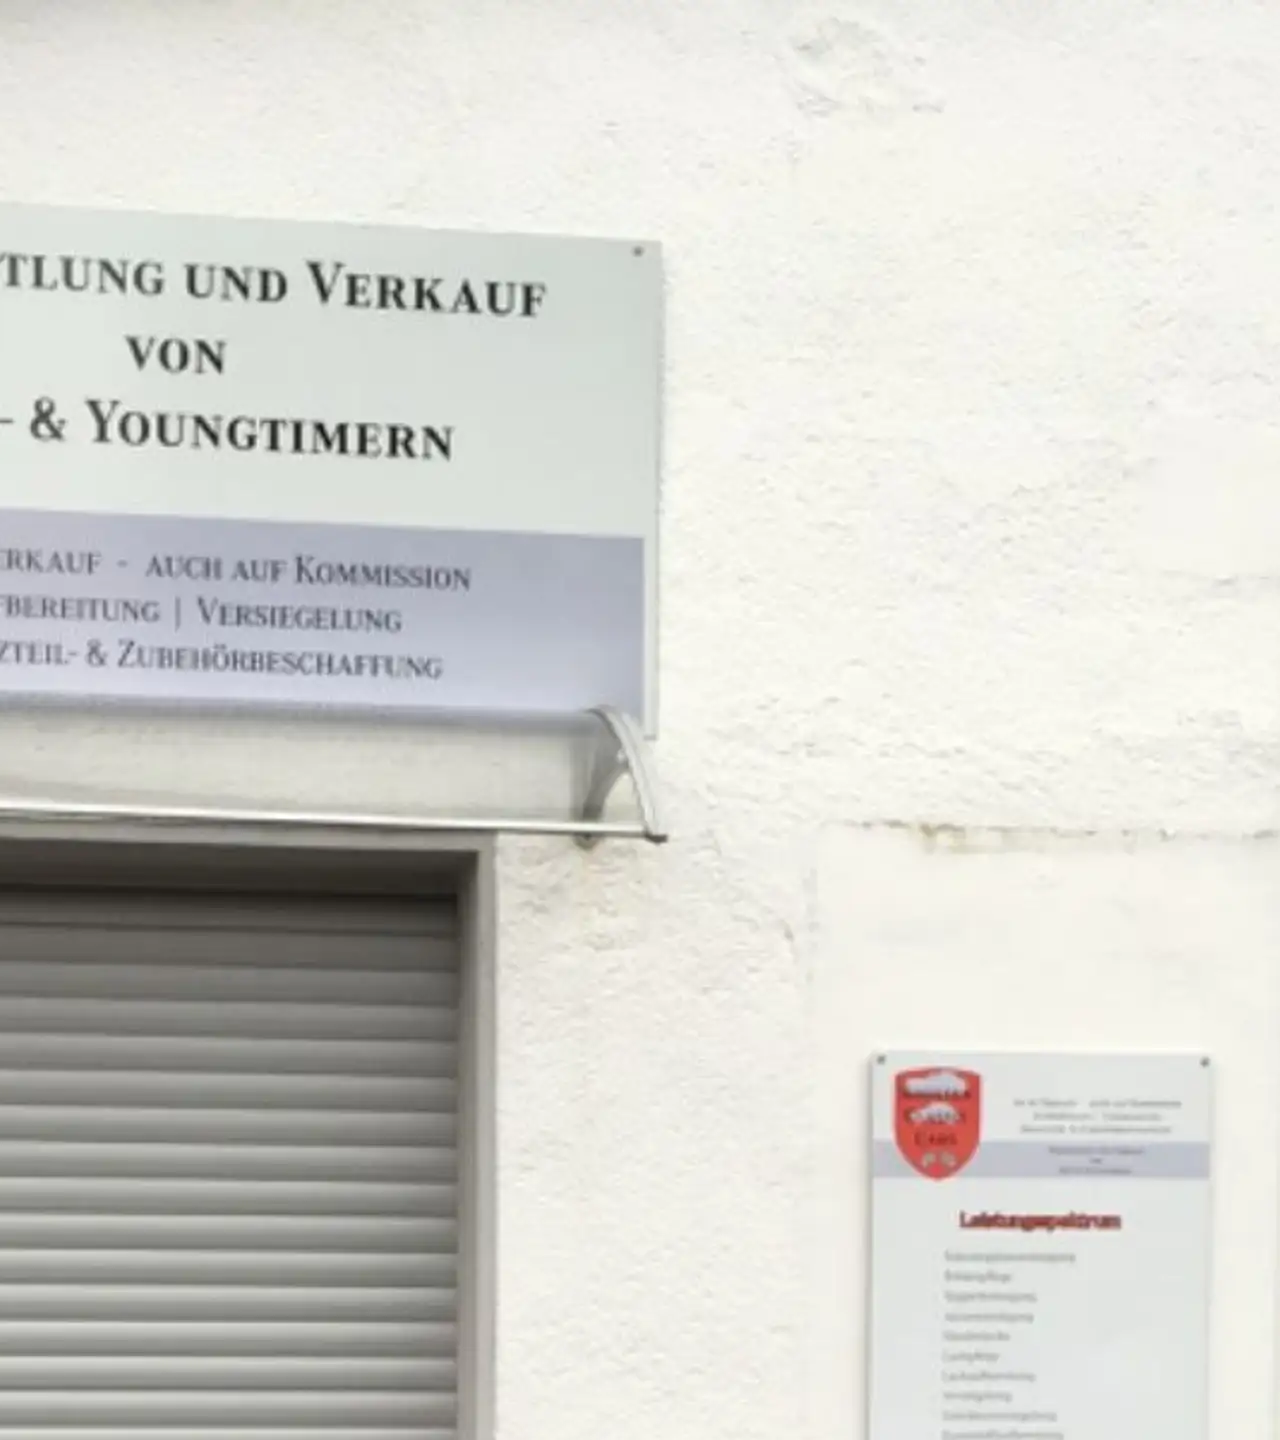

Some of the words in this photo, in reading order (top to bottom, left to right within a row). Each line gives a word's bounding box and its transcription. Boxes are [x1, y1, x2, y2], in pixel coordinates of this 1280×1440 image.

[183, 263, 289, 303] UND
[307, 260, 548, 318] VERKAUF
[124, 335, 227, 375] VON
[29, 397, 67, 442] &
[85, 398, 457, 461] YOUNGTIMERN
[145, 555, 223, 583] AUCH
[231, 557, 288, 584] AUF
[293, 556, 473, 593] KOMMISSION
[196, 599, 404, 634] VERSIEGELUNG
[86, 638, 108, 668] &
[116, 639, 444, 681] ZUBEHÖRBESCHAFFUNG
